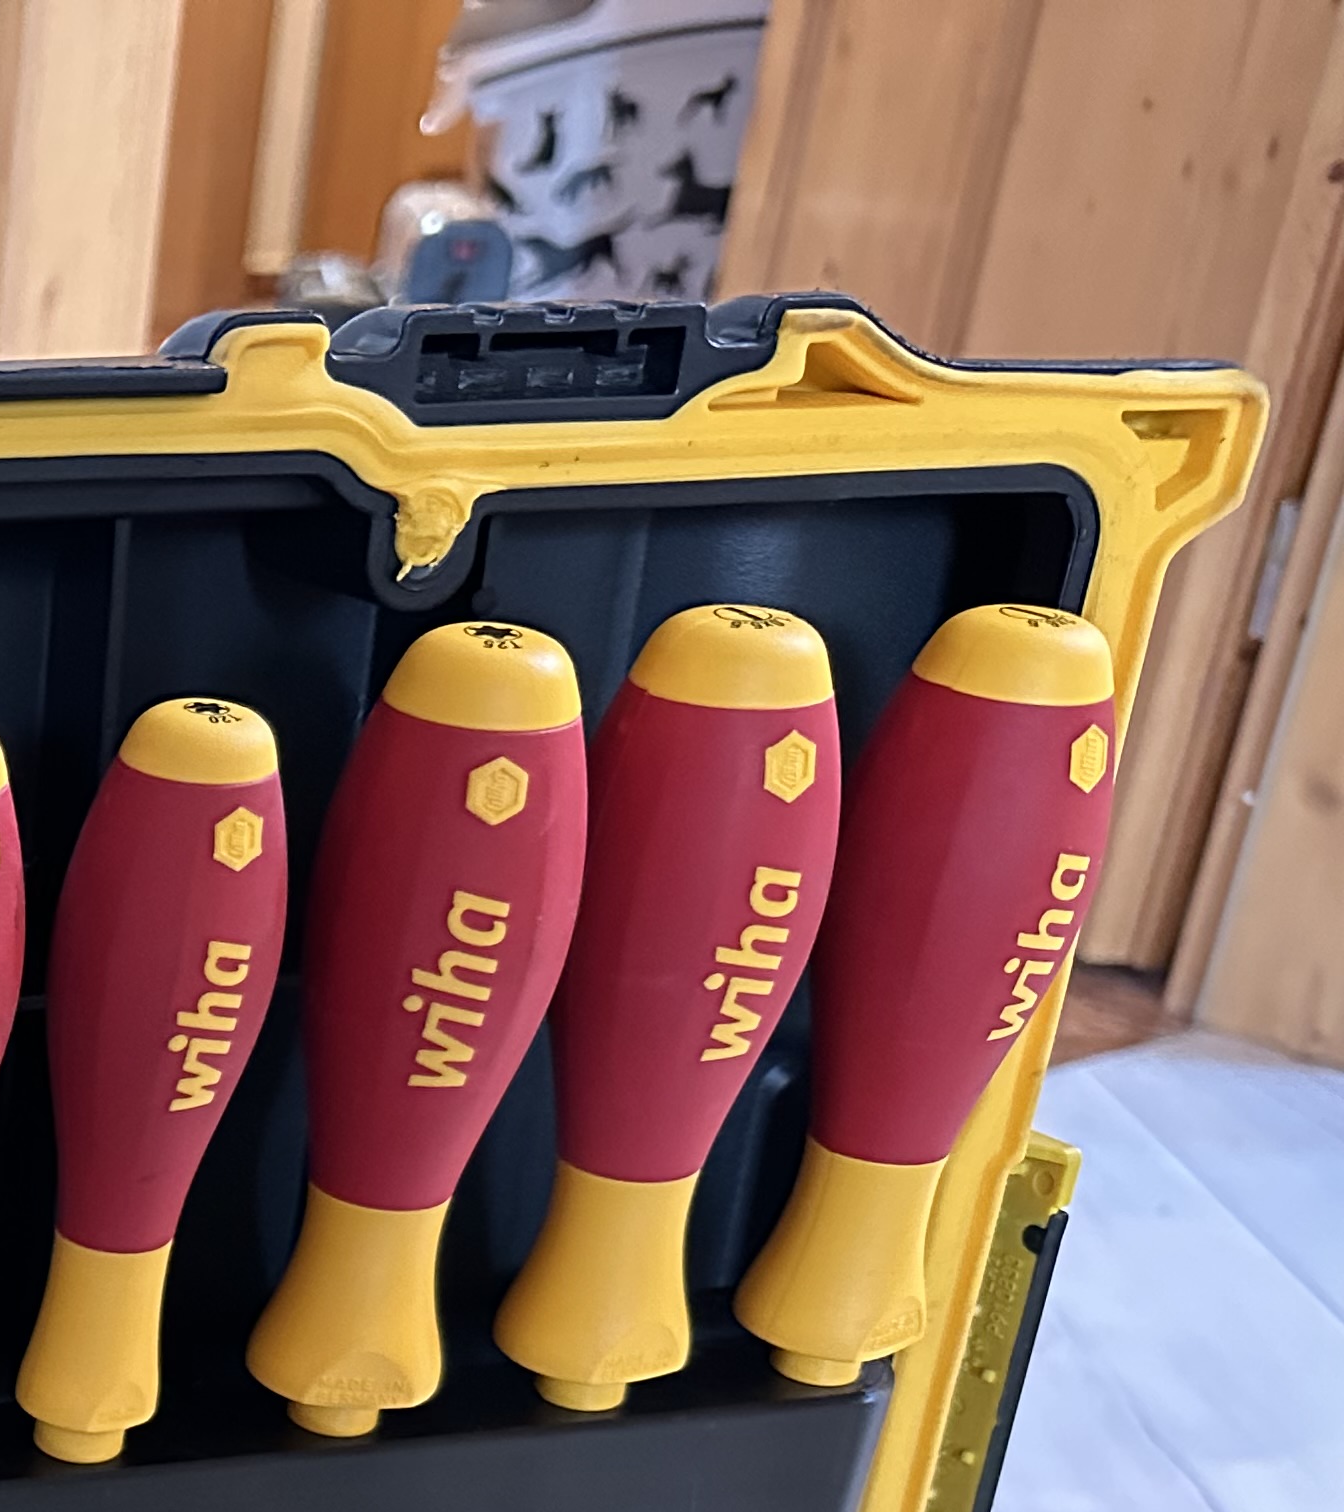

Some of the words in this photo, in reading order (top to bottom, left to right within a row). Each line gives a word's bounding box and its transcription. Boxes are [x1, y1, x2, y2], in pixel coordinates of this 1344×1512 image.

[209, 713, 243, 724] T20
[169, 941, 251, 1110] wiha
[405, 892, 509, 1087] wiha
[702, 867, 801, 1062] wiha
[985, 852, 1091, 1042] wiha
